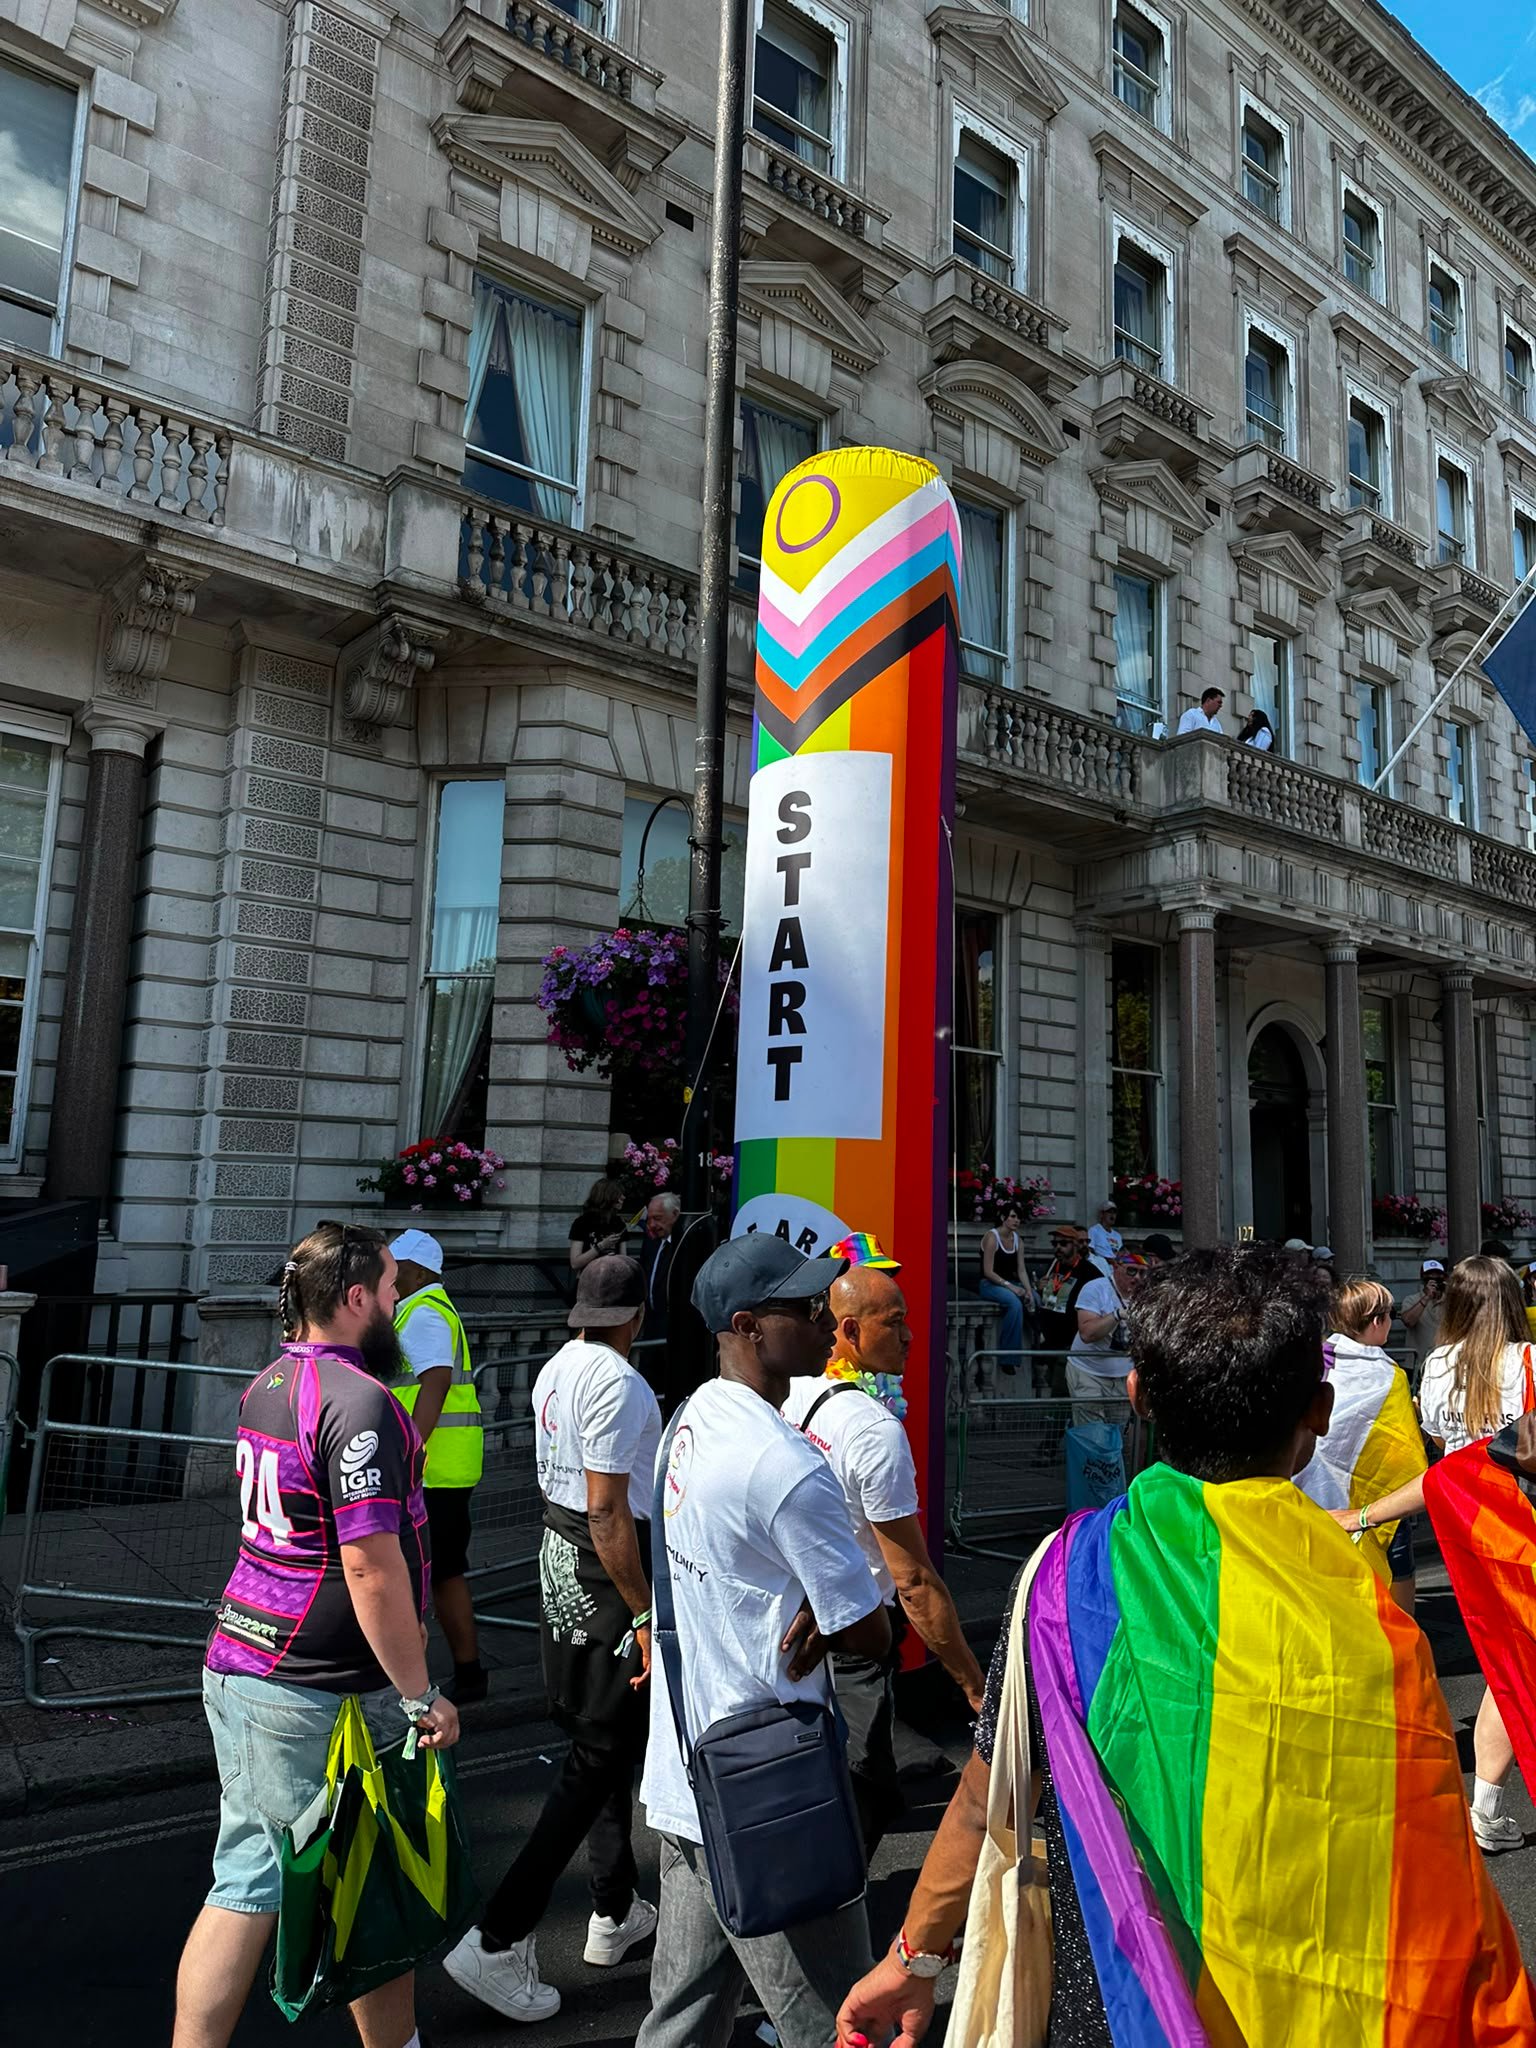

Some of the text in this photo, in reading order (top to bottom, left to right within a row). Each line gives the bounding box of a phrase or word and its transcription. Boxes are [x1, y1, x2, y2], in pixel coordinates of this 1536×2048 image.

[767, 790, 812, 1102] START
[698, 1151, 713, 1167] 18
[1238, 1226, 1254, 1241] 127
[236, 1439, 294, 1546] 24
[340, 1467, 382, 1494] IGR
